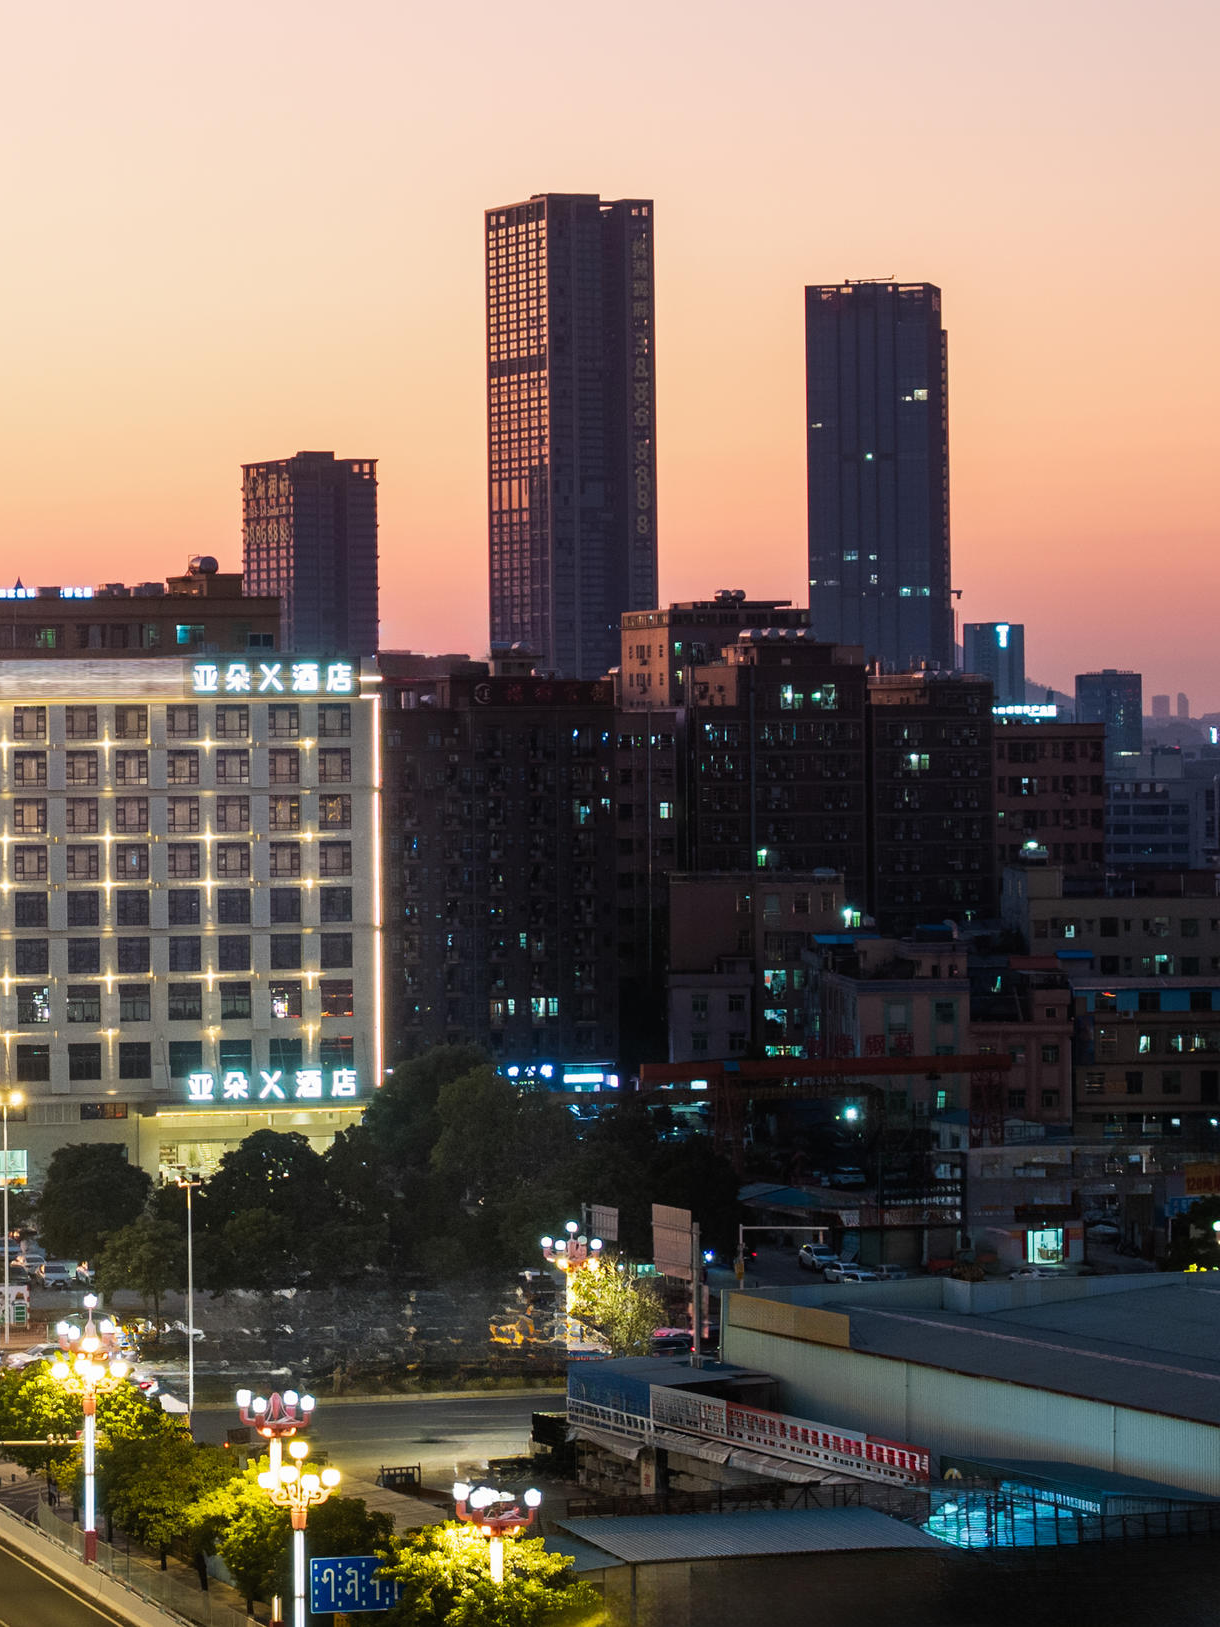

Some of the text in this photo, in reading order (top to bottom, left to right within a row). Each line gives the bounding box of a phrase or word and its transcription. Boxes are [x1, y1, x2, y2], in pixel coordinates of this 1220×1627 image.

[193, 663, 352, 691] 亚朵X酒店
[188, 1068, 357, 1100] 亚朵X酒店
